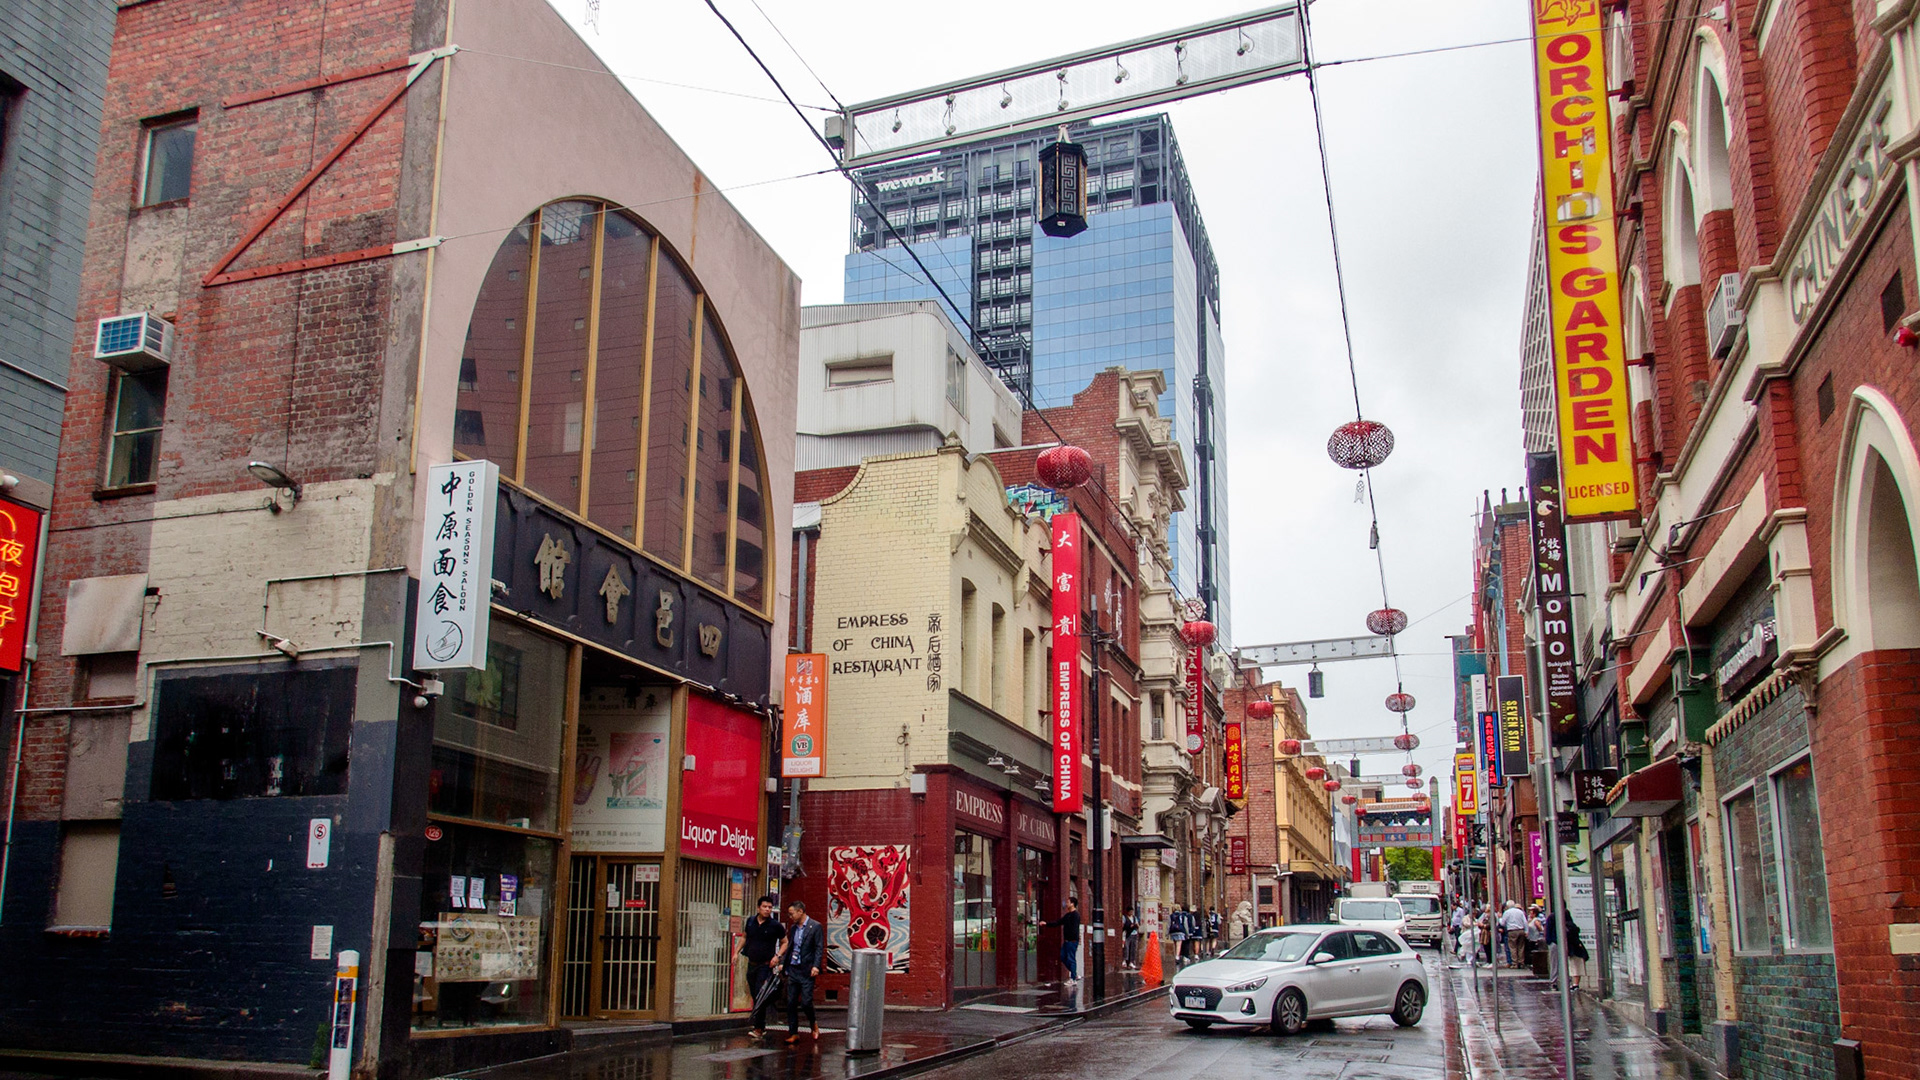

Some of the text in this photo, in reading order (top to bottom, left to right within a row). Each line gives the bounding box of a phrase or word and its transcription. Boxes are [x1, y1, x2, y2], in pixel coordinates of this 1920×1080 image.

[875, 166, 946, 193] wework
[1790, 90, 1893, 324] CHINESE
[1560, 266, 1618, 466] GARDEN
[1568, 481, 1630, 499] LICENSED
[427, 471, 462, 616] 中原面食
[459, 471, 476, 612] GOLDEN SEASONS SALOON
[833, 635, 915, 653] OF CHINA
[837, 613, 908, 629] EMPRESS
[832, 658, 922, 678] RESTAURANT
[1059, 661, 1071, 801] EMPRESS OF CHINA
[1506, 700, 1520, 752] SEVEN STAR
[1228, 743, 1241, 795] 北京同仁堂
[1462, 784, 1473, 800] 7
[428, 827, 440, 838] 126
[682, 816, 755, 857] Liquor Delight
[956, 790, 1003, 824] EMPRESS
[1030, 818, 1056, 842] CHINA
